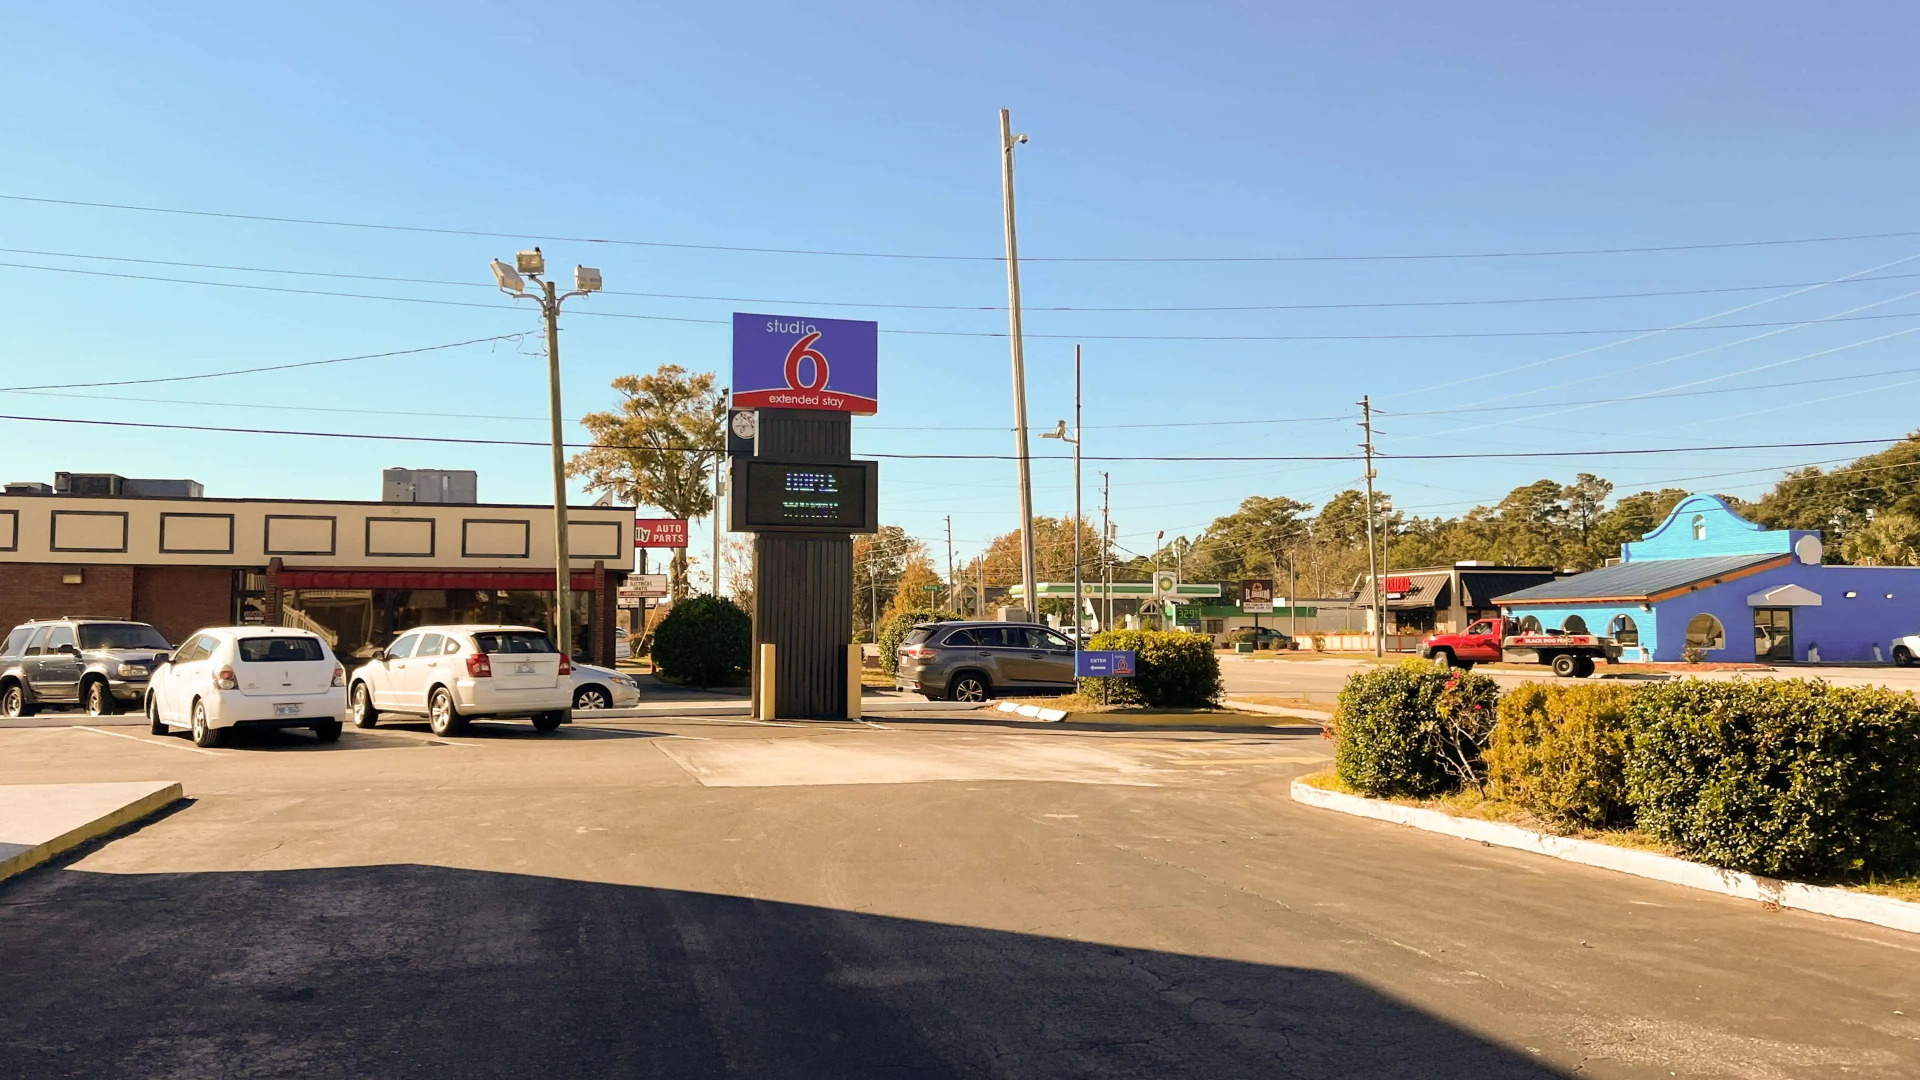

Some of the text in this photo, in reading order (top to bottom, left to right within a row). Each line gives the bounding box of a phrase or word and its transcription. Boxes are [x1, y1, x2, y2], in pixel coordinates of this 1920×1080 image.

[766, 320, 817, 335] studio
[784, 331, 829, 391] 6
[769, 394, 844, 408] extended stay
[656, 524, 682, 533] AUTO
[653, 534, 684, 542] PARTS
